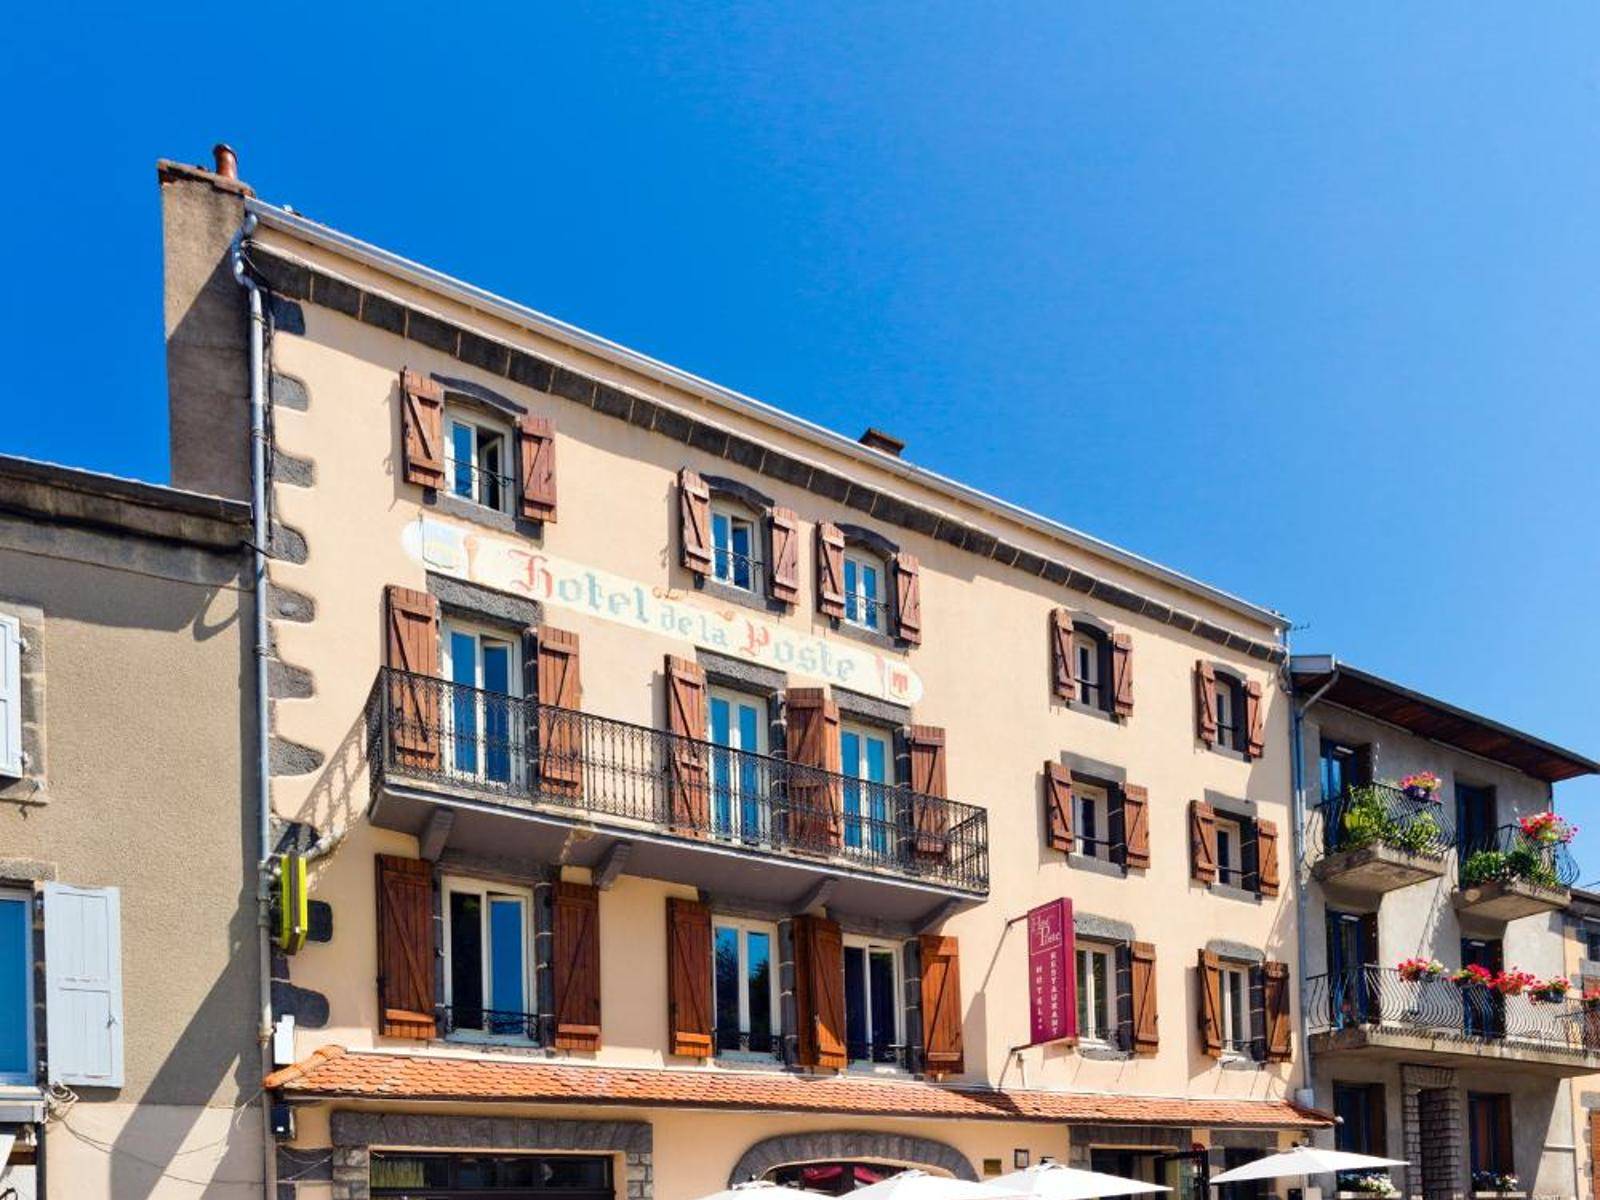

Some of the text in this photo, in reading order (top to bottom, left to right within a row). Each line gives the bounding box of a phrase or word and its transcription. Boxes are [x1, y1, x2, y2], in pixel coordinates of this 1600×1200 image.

[660, 605, 692, 635] de
[700, 614, 728, 647] la
[739, 619, 855, 682] Poste
[1050, 951, 1058, 1035] RESTAURANT
